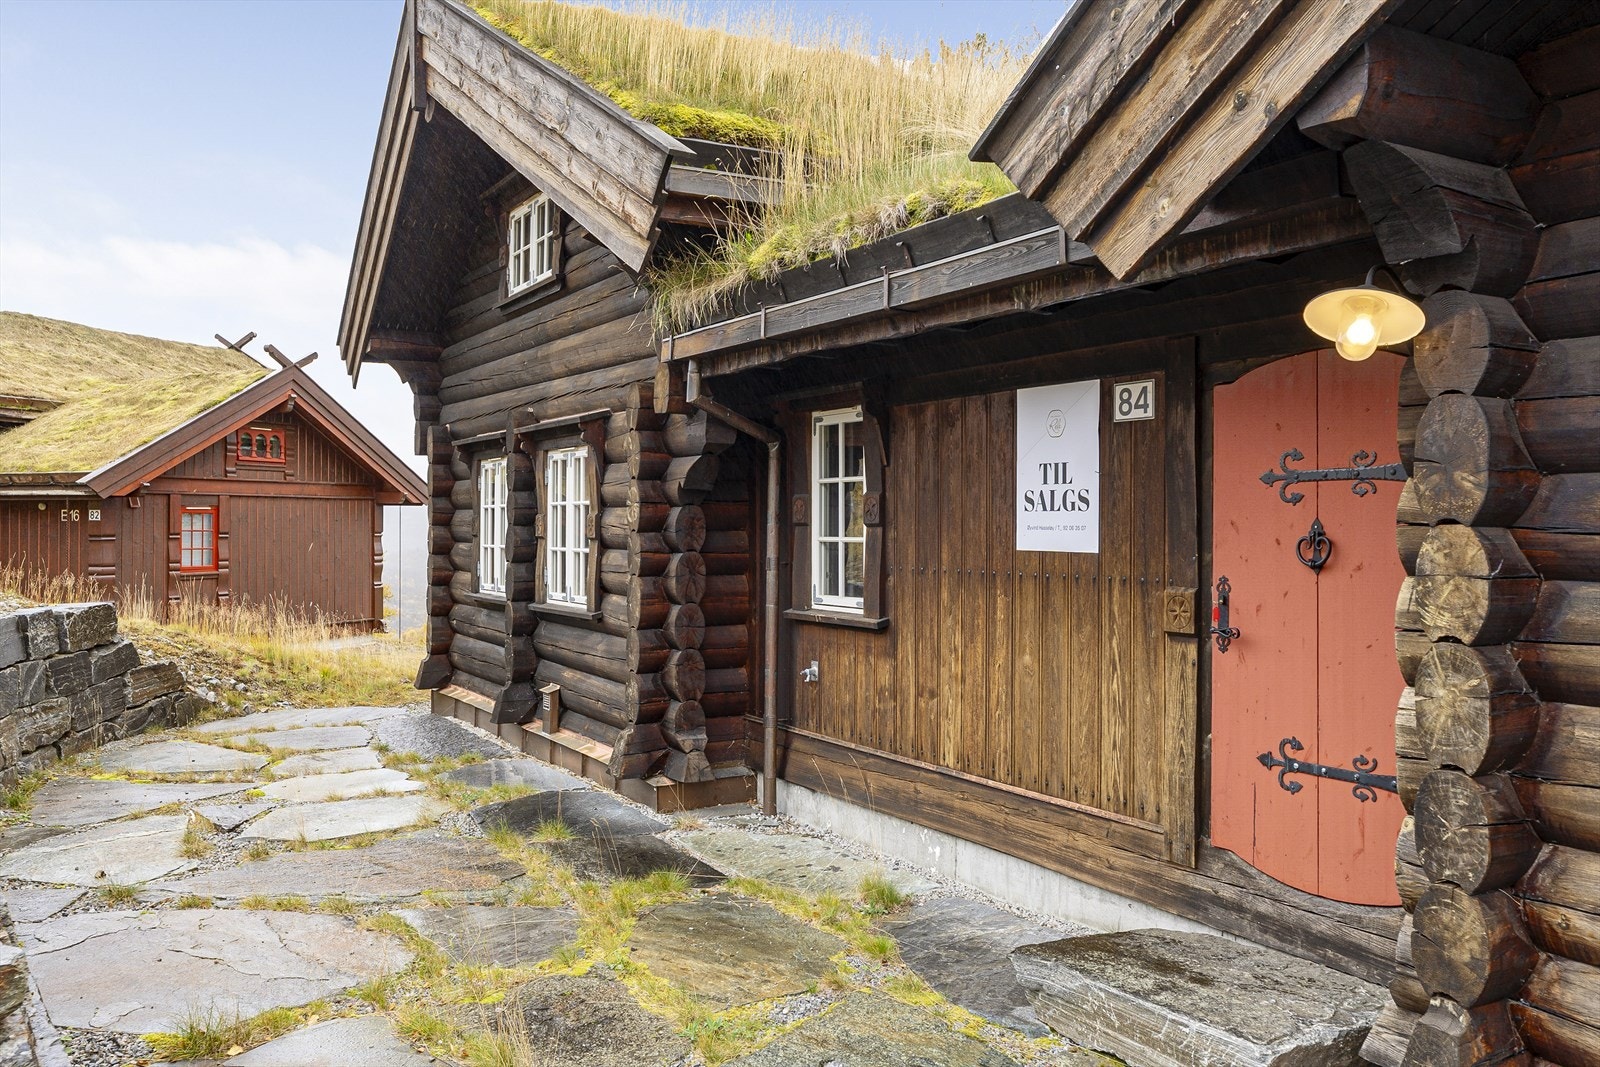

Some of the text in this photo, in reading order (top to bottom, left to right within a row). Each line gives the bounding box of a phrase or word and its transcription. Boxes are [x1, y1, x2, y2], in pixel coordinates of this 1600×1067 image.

[1119, 386, 1149, 416] 84
[1039, 462, 1073, 485] TIL
[1024, 489, 1090, 512] SALGS
[90, 511, 99, 519] 82
